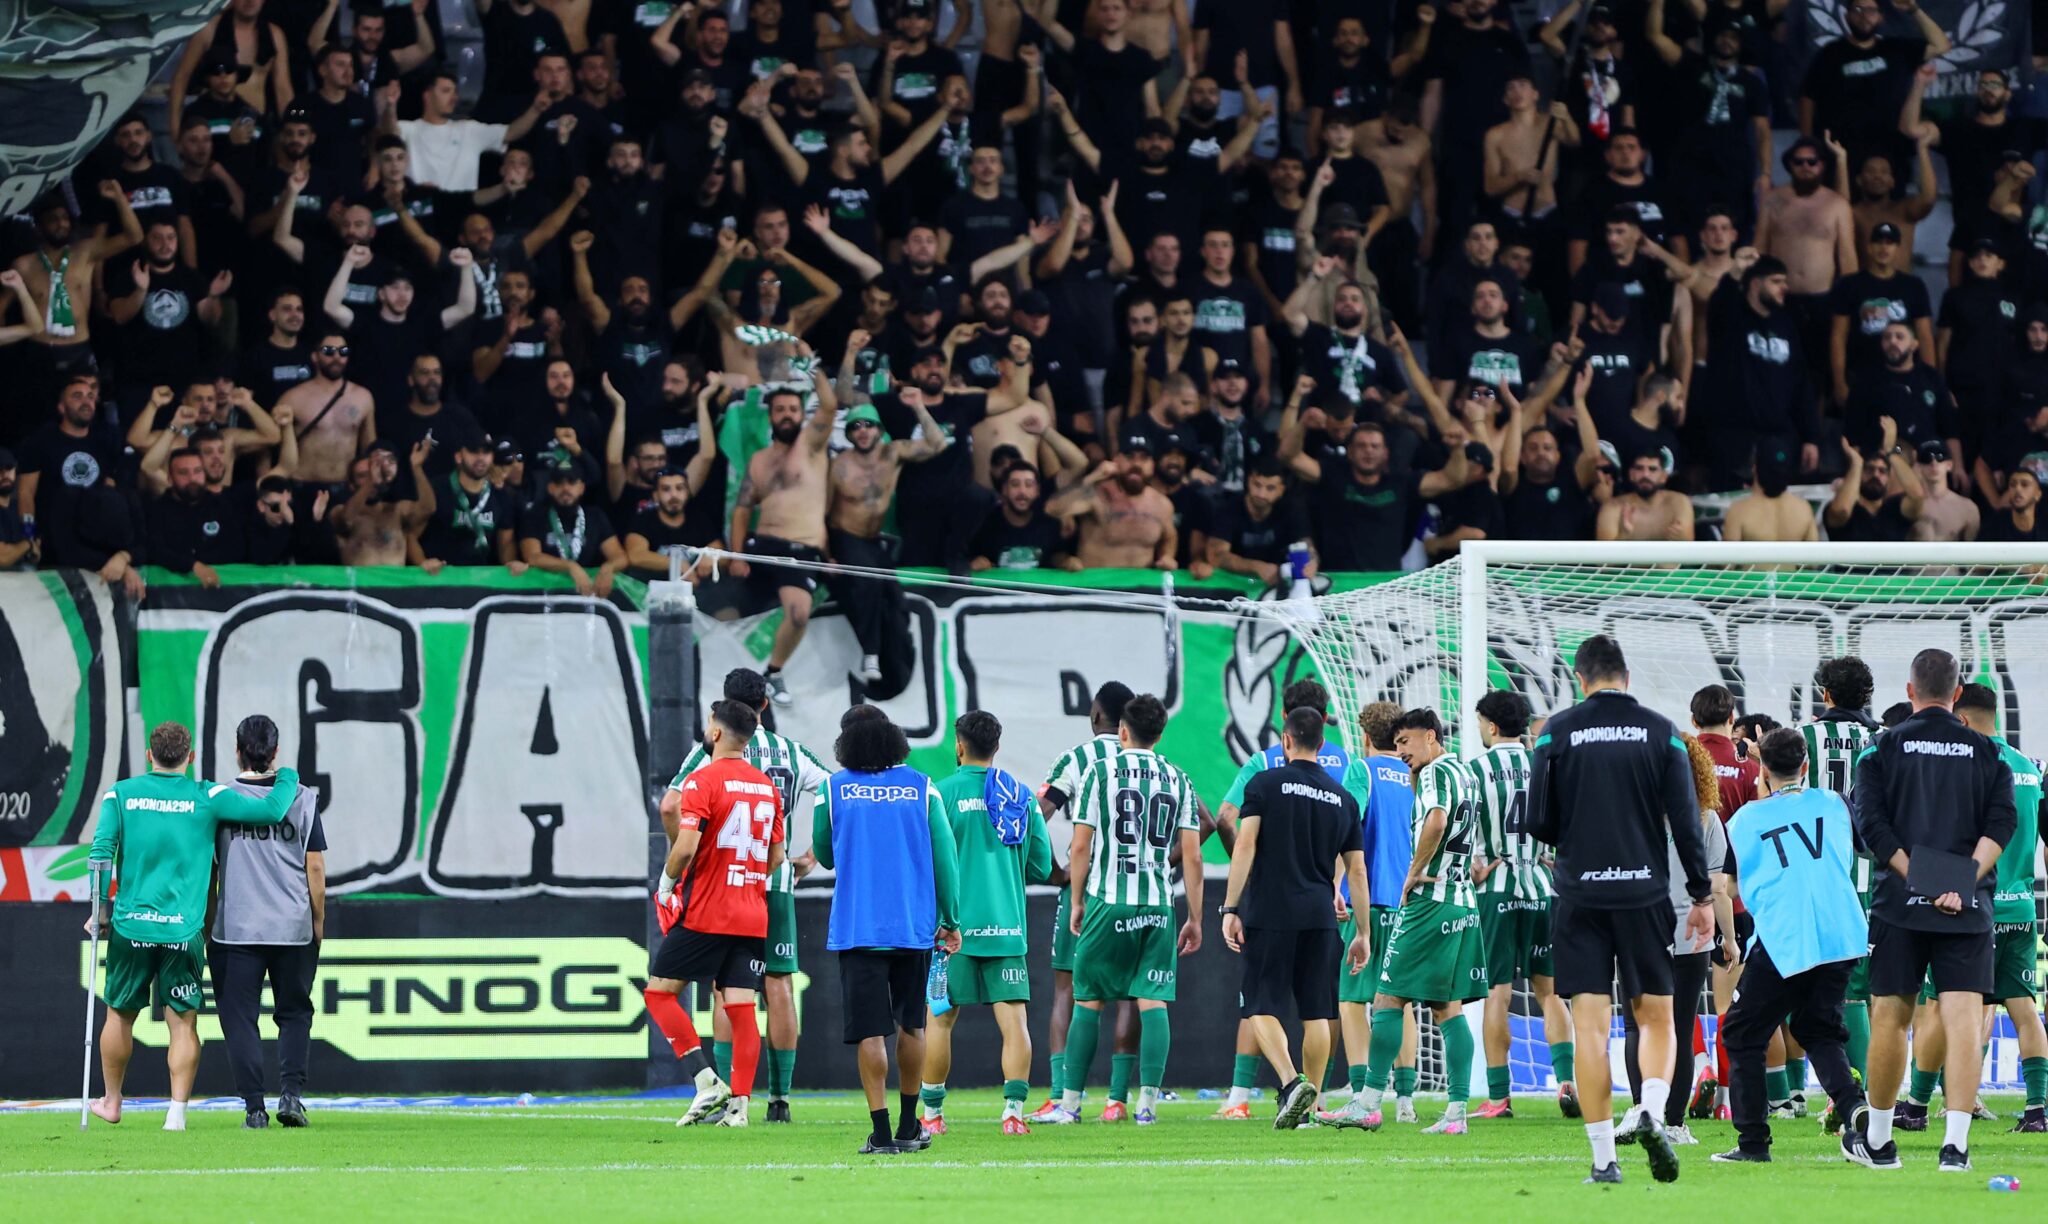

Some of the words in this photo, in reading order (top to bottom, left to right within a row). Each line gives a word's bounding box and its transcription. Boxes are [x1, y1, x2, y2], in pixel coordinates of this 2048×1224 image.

[1570, 726, 1648, 746] OMONOIA29M
[1903, 740, 1974, 758] OMONOIA29M
[1377, 767, 1411, 786] Kap
[840, 783, 919, 802] Kappa
[1281, 782, 1343, 807] OMONOIA29M
[126, 797, 195, 814] OMONOIA29M
[1114, 787, 1180, 849] 80
[1505, 788, 1532, 847] 4
[716, 799, 776, 864] 43
[1760, 816, 1824, 869] TV
